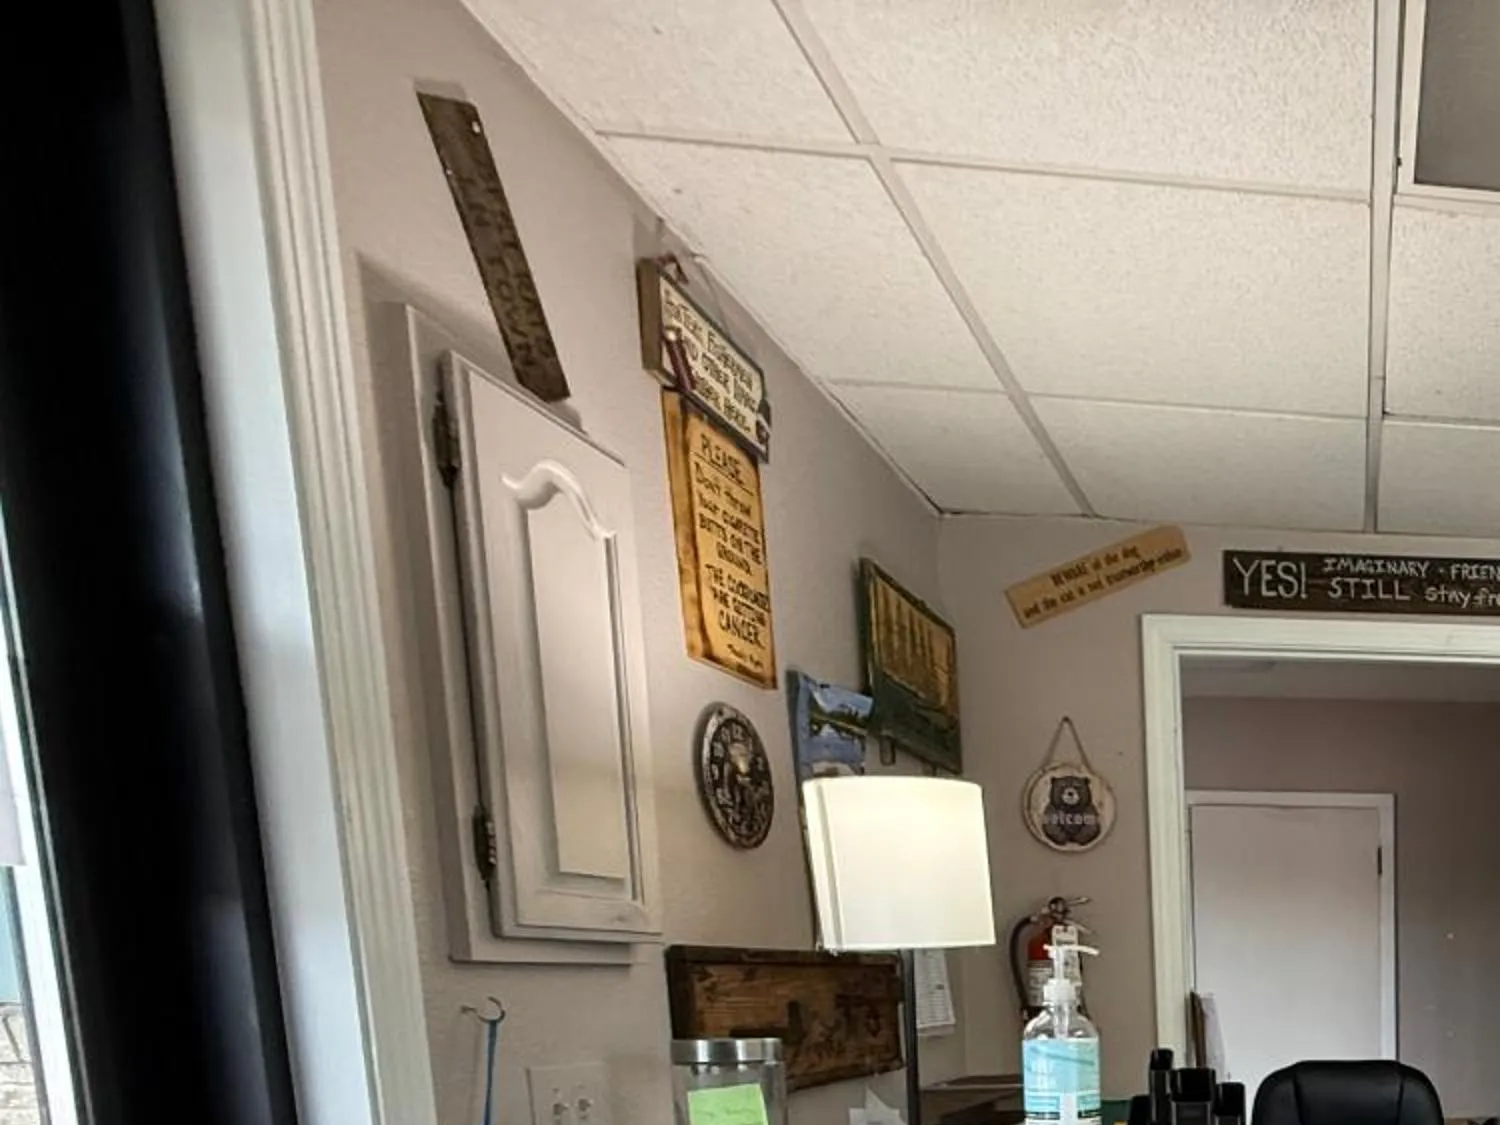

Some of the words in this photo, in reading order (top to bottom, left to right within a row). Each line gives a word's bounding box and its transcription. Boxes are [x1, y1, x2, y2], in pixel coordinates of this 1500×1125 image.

[1232, 557, 1307, 599] YES!
[1323, 557, 1430, 577] IMAGINARY
[1328, 577, 1411, 600] STILL
